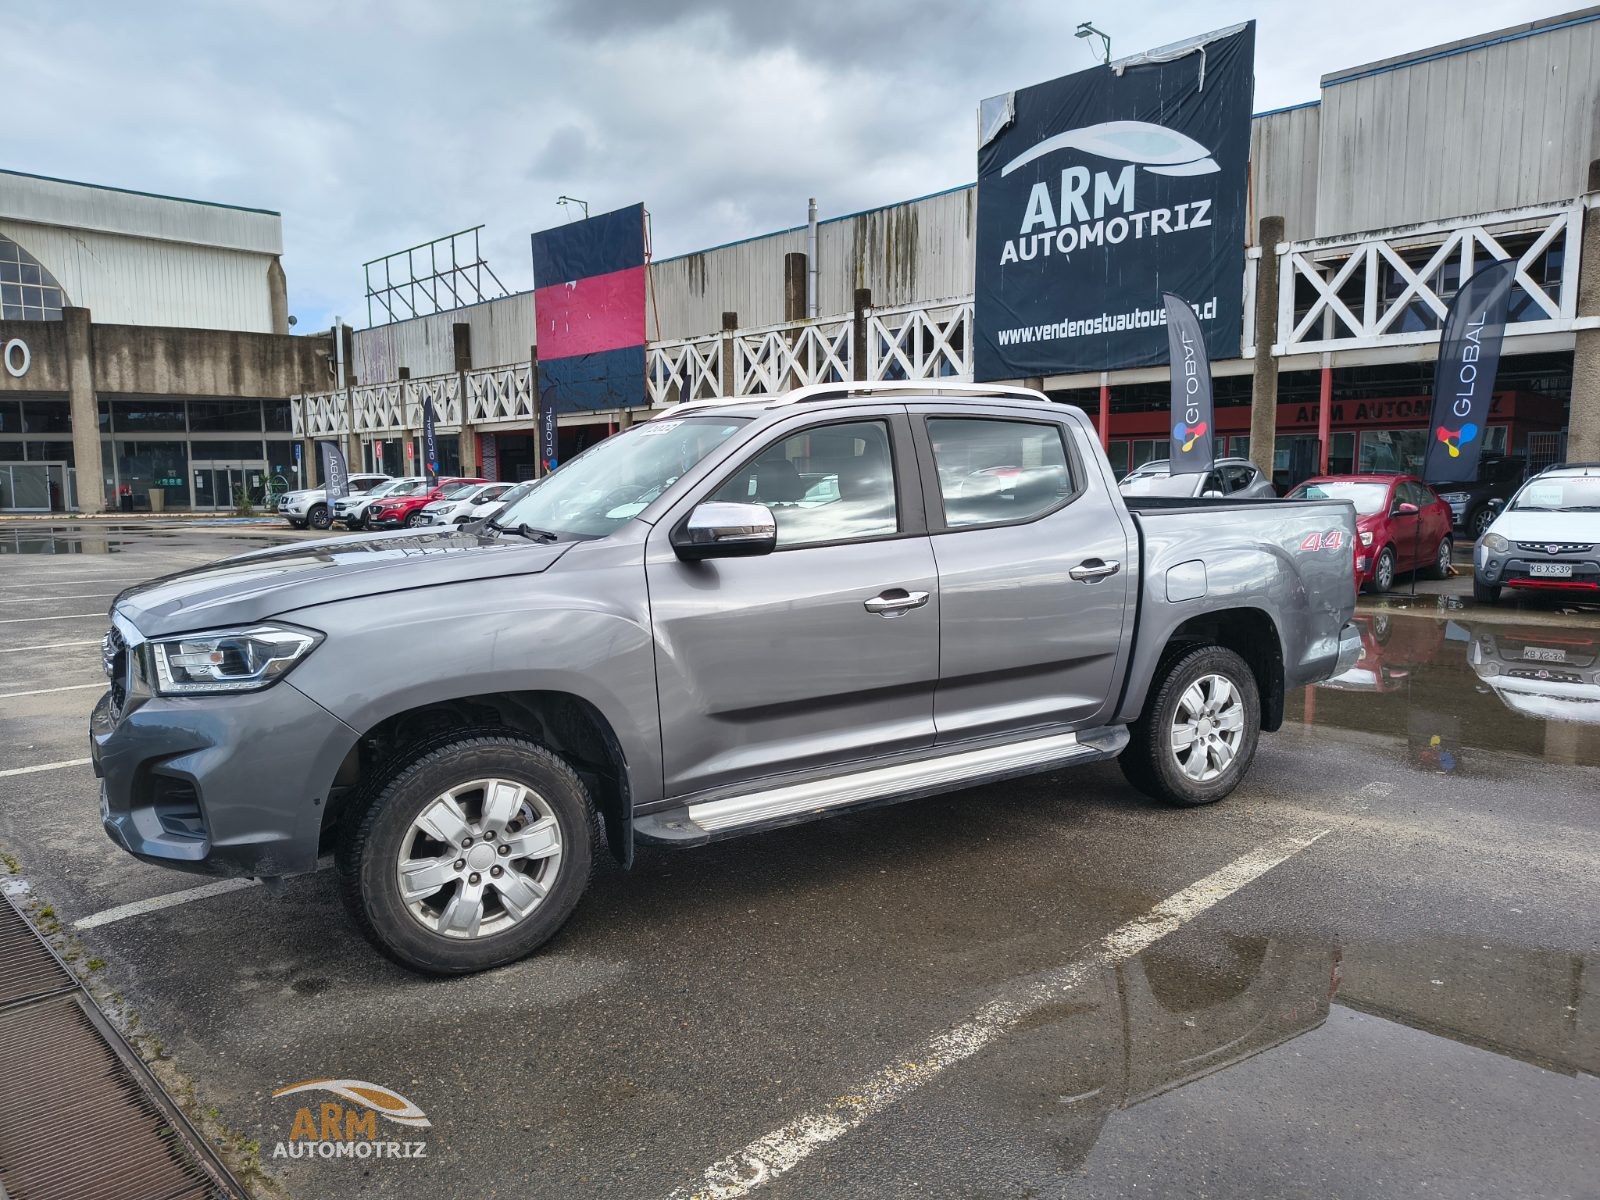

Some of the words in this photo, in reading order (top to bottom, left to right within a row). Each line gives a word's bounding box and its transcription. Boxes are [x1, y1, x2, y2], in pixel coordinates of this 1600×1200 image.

[1019, 164, 1136, 235] ARM
[999, 198, 1212, 266] AUTOMOTRIZ
[998, 297, 1218, 346] www.vendenostuautous.cl
[1453, 311, 1487, 417] GLOBAL
[1355, 395, 1503, 420] AUTOMZ
[427, 416, 435, 460] GLOBAL
